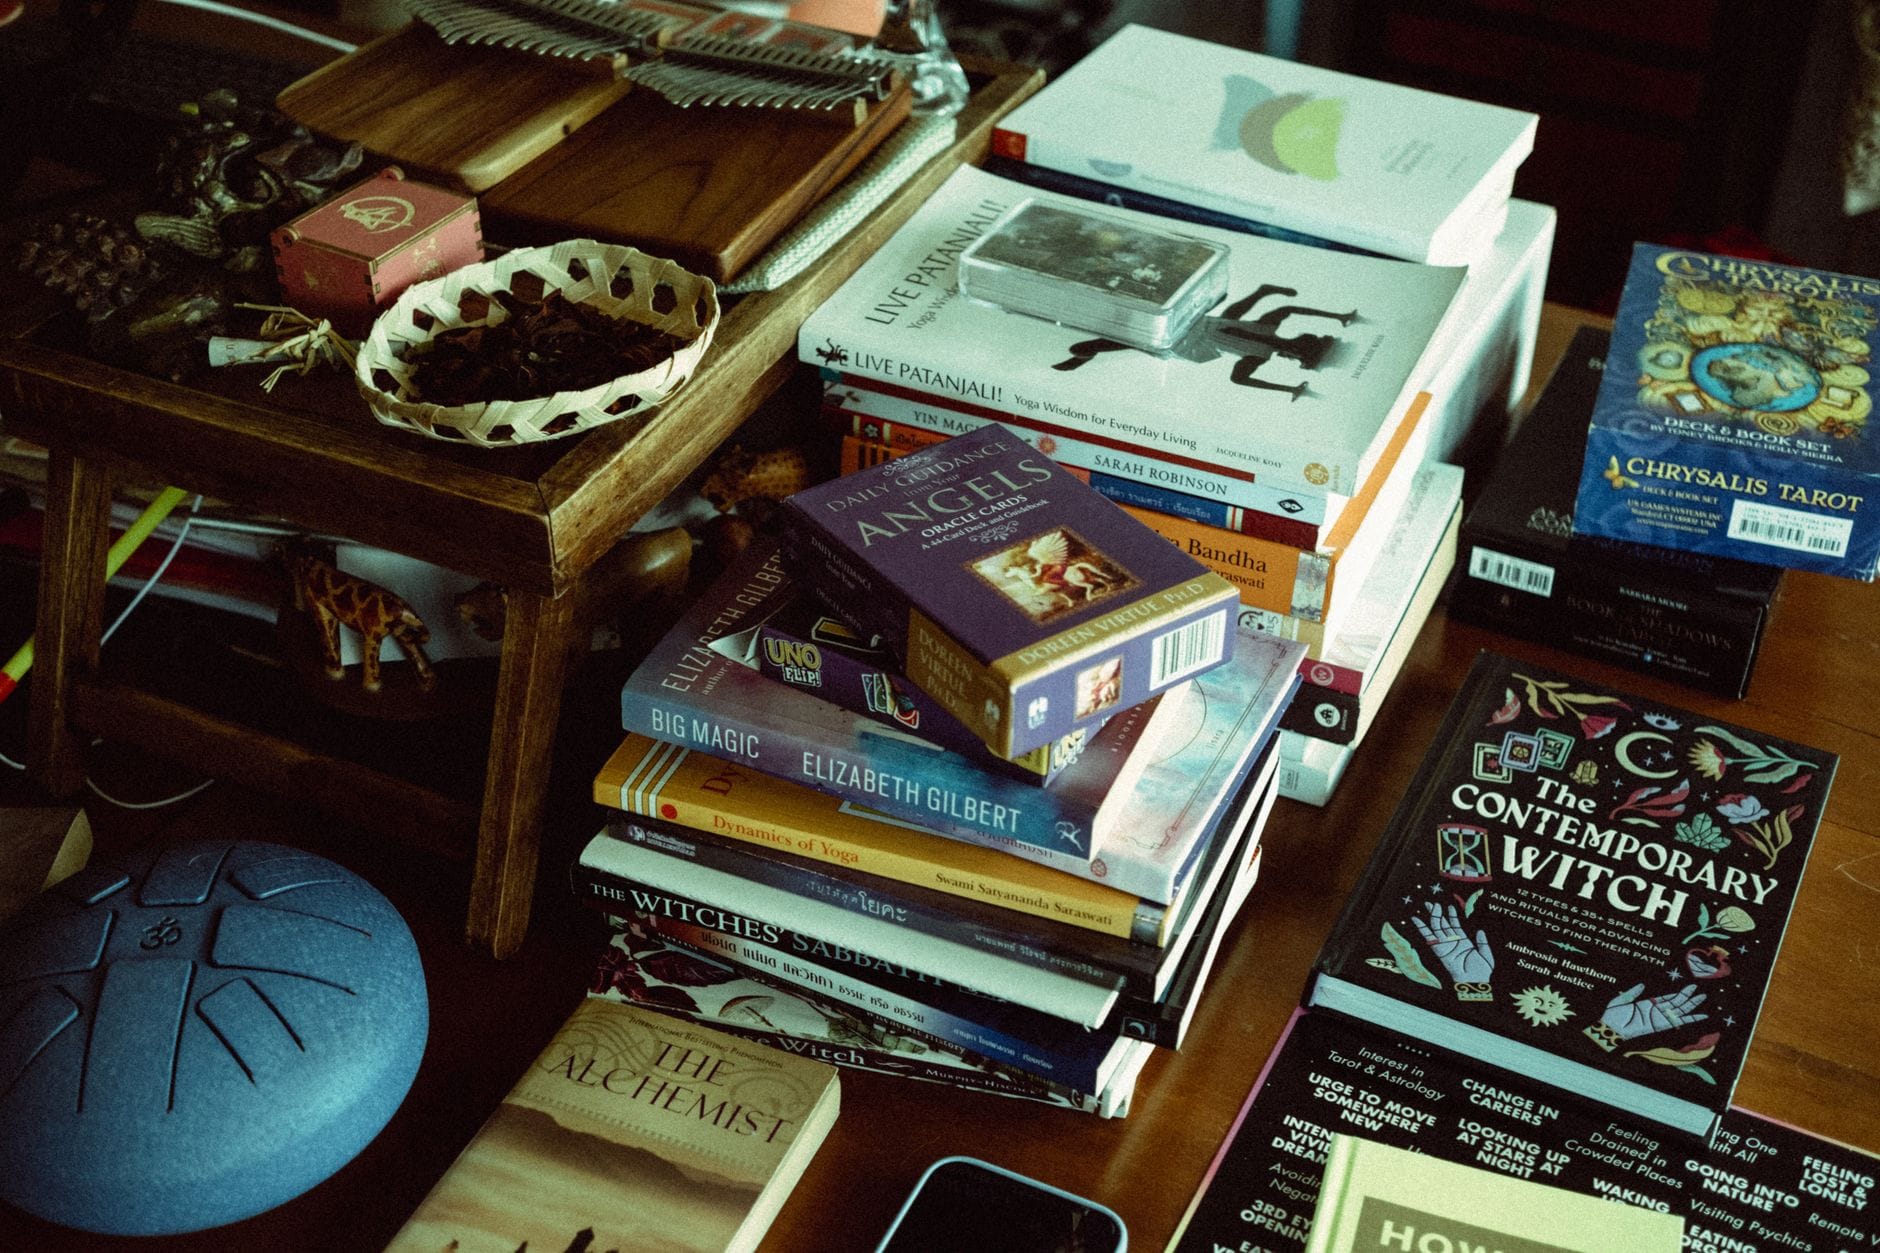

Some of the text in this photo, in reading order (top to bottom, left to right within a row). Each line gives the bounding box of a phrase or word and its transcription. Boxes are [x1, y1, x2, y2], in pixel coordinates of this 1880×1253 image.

[865, 199, 1008, 325] LIVE PATANJALI!
[1655, 251, 1880, 295] CHRYSALIS
[906, 305, 936, 329] Yoga
[855, 352, 893, 375] LIVE
[899, 363, 1003, 402] PATANJALI!
[1014, 394, 1039, 411] Yoga
[1044, 402, 1088, 421] Wisdom
[1091, 412, 1106, 426] for
[1109, 417, 1160, 440] Everyday
[1162, 431, 1197, 450] Living
[1216, 446, 1260, 464] JACQUELINE
[913, 410, 938, 425] YIN
[1650, 423, 1665, 432] BY
[1707, 433, 1754, 448] BROOKS
[1764, 440, 1800, 456] HOLLY
[1801, 449, 1843, 464] SIERRA
[1664, 416, 1831, 453] DECK & BOOK SET
[827, 441, 1012, 513] DAILY GUIDANCE
[1094, 454, 1228, 497] SARAH ROBINSON
[1626, 457, 1863, 513] CHRYSALIS TAROT
[857, 459, 1052, 548] ANGELS
[921, 494, 1028, 538] ORACLE CARDS
[921, 498, 1049, 550] A 44-Card Deck and Guidebook
[1188, 538, 1268, 573] Bandha
[764, 637, 822, 670] UNO
[919, 628, 972, 681] DOREEN
[1019, 629, 1094, 665] DOREEN
[702, 666, 728, 696] author
[783, 662, 822, 687] FLIP!
[920, 648, 966, 695] VIRTUE
[652, 708, 1021, 833] BIG MAGIC ELIZABETH GILBERT
[1537, 776, 1597, 814] The
[1451, 783, 1779, 906] CONTEMPORARY
[713, 815, 792, 846] Dynamics
[797, 838, 814, 852] of
[821, 844, 860, 865] Yoga
[936, 872, 975, 891] Swami
[977, 884, 1049, 911] Satyananda
[1053, 900, 1112, 926] Saraswati
[1502, 835, 1690, 928] WITCH
[590, 883, 625, 901] THE
[858, 890, 907, 921] โยคะ
[1517, 887, 1654, 939] 12 TYPES & 35+ SPELLS
[1488, 903, 1665, 967] WITCHES TO FIND THEIR PATH
[1491, 892, 1672, 956] AND RITUALS FOR ADVANCING
[1505, 941, 1617, 984] Ambrosia Hawthorn
[1517, 958, 1594, 991] Sarah Justice
[629, 1016, 684, 1039] INTERNATIONAL
[730, 1046, 784, 1069] PHENOMENON
[654, 1040, 735, 1087] THE
[777, 1037, 864, 1065] Witch
[1359, 1047, 1425, 1077] Interest in
[1328, 1050, 1447, 1101] Tarot & Astrology
[548, 1054, 793, 1144] ALCHEMIST
[1308, 1072, 1437, 1127] URGE TO MOVE
[1313, 1087, 1421, 1134] SOMEWHERE
[1462, 1078, 1560, 1120] CHANGE IN
[1469, 1093, 1542, 1126] CAREERS
[1340, 1110, 1384, 1132] NEW
[1458, 1119, 1571, 1165] LOOKING UP
[1607, 1123, 1660, 1151] Feeling
[1456, 1132, 1563, 1176] AT STARS AT
[1476, 1151, 1534, 1179] NIGHT
[1564, 1140, 1684, 1189] Crowded Places
[1590, 1132, 1667, 1168] Drained in
[1735, 1149, 1758, 1163] All
[1745, 1137, 1778, 1156] One
[1685, 1159, 1800, 1208] GOING INTO
[1803, 1155, 1875, 1189] FEELING
[1804, 1168, 1867, 1199] LOST &
[1251, 1200, 1287, 1221] 3RD
[1592, 1178, 1671, 1214] WAKING
[1703, 1178, 1775, 1212] NATURE
[1798, 1179, 1868, 1211] LONELY
[1689, 1224, 1758, 1253] EATING
[1690, 1199, 1813, 1253] Visiting Psychics
[1808, 1212, 1865, 1241] Remote
